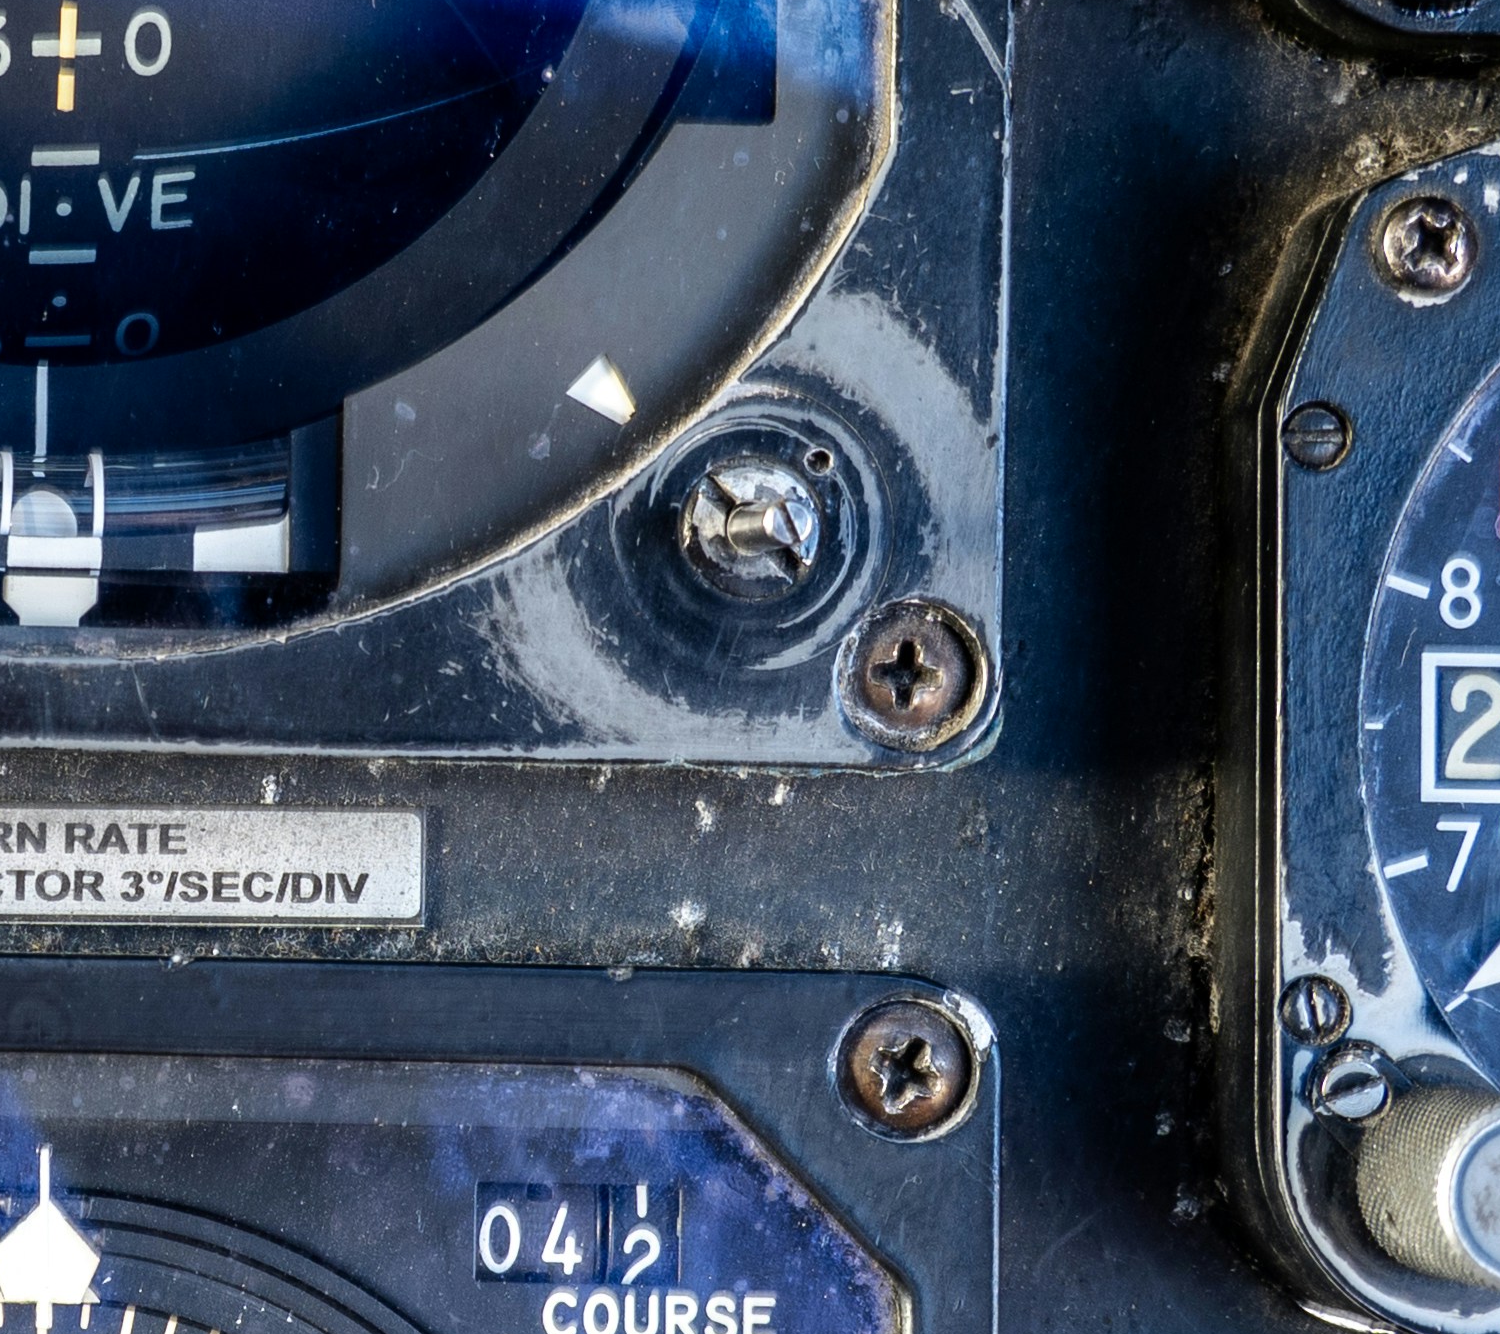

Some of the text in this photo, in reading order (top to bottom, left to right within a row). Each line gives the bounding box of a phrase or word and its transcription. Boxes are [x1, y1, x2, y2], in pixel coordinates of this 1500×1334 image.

[1439, 557, 1481, 629] 8
[64, 822, 188, 856] RATE
[1436, 820, 1480, 892] 7
